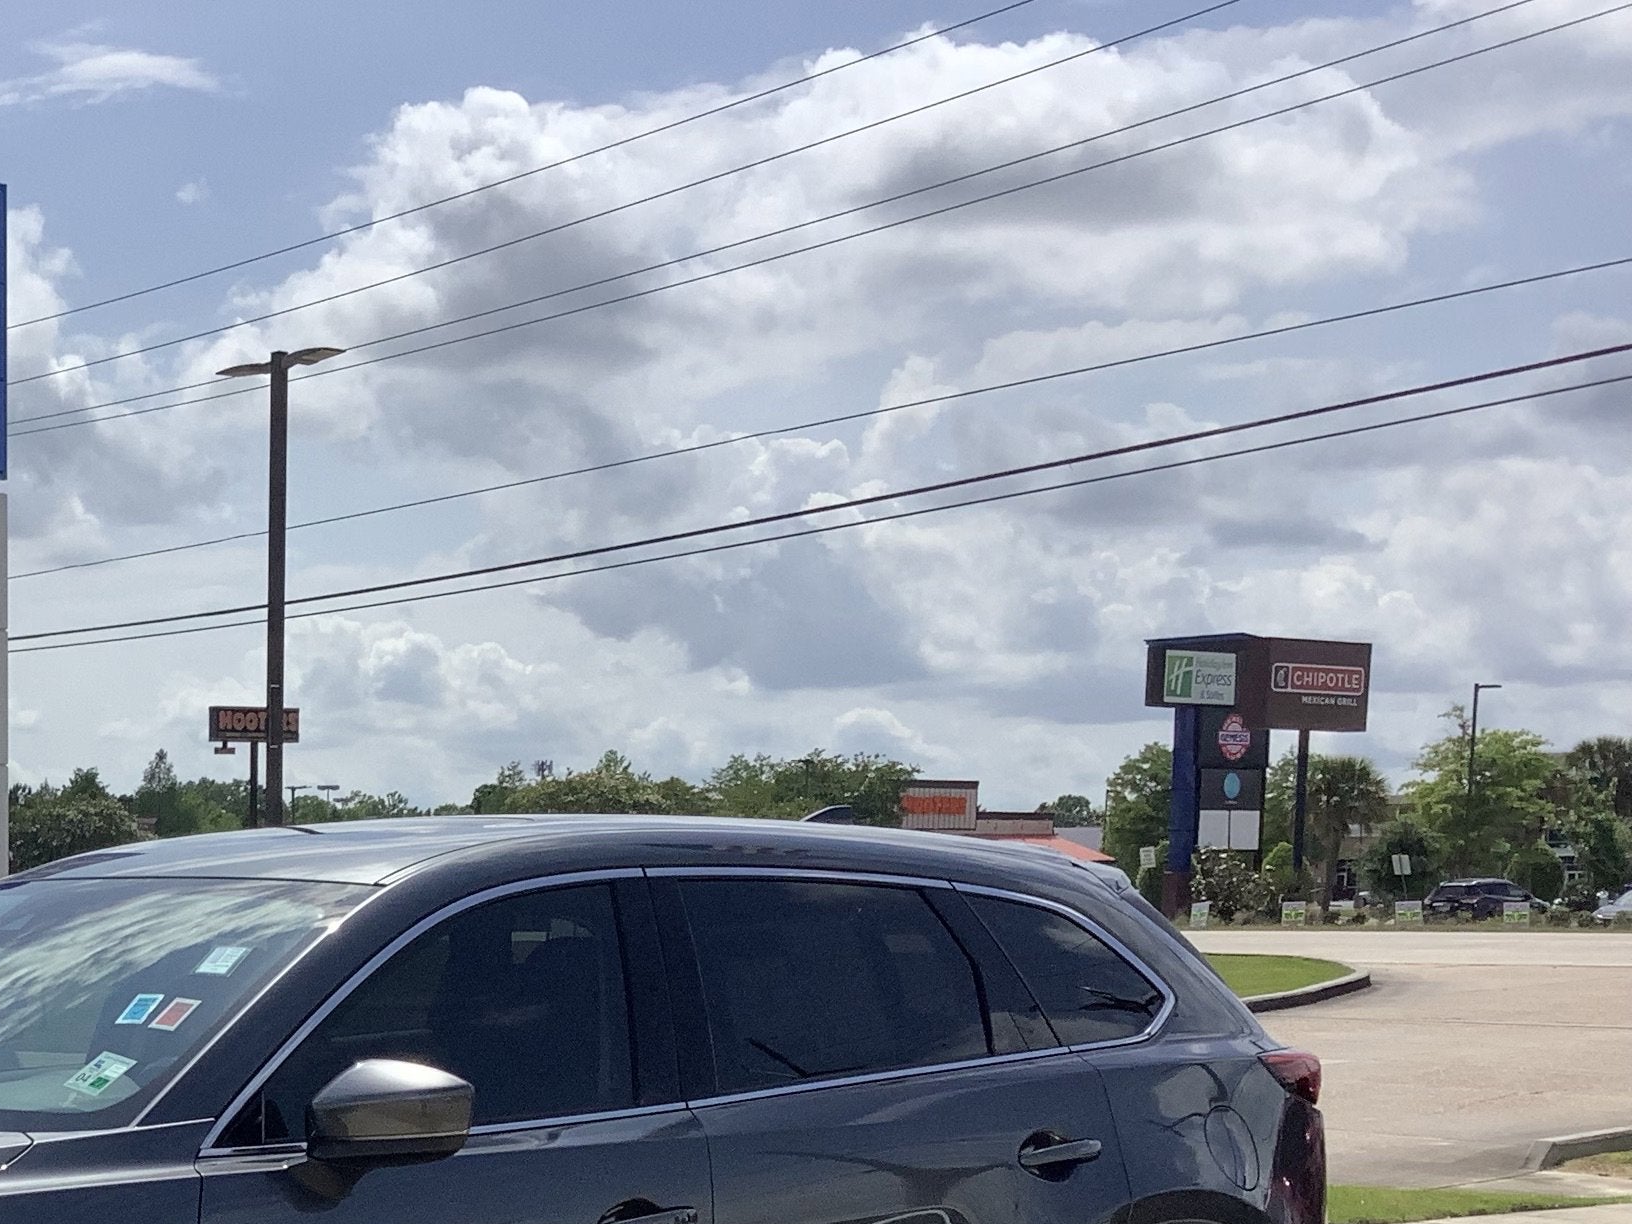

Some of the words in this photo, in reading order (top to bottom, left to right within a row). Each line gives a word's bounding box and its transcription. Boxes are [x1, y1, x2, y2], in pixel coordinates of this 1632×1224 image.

[1195, 668, 1232, 688] Express
[1293, 670, 1360, 689] CHIPOTLE
[1302, 696, 1335, 705] MEXICAN
[1337, 697, 1358, 706] GRILL
[218, 710, 298, 732] HOOTS
